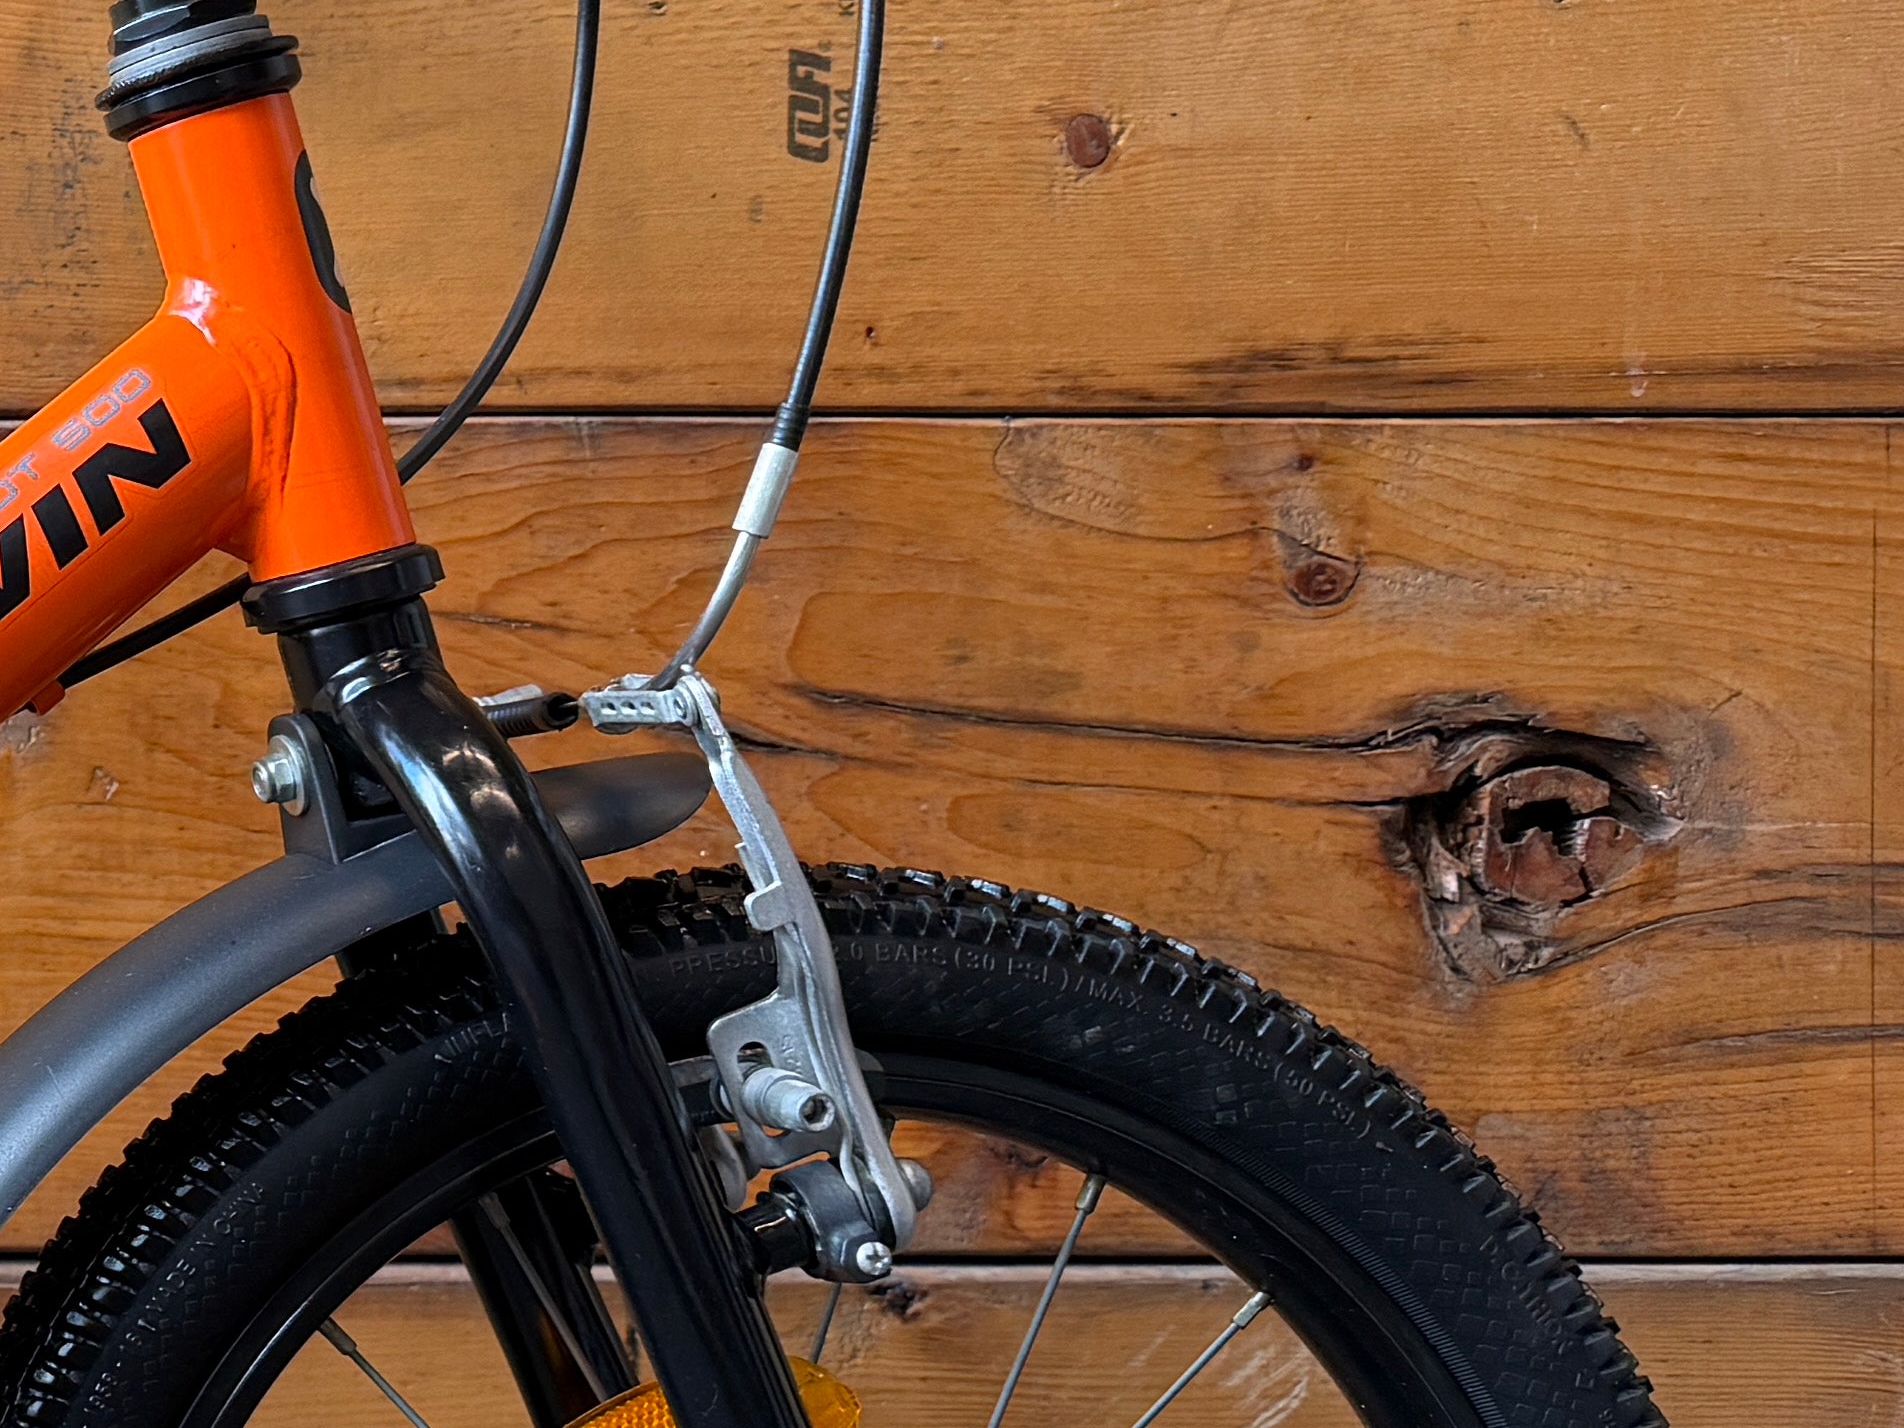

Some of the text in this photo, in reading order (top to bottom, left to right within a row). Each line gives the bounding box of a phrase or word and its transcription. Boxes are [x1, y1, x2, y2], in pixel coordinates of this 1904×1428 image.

[58, 368, 152, 451] 500
[874, 938, 950, 969] BARS
[1198, 1020, 1274, 1073] BARS
